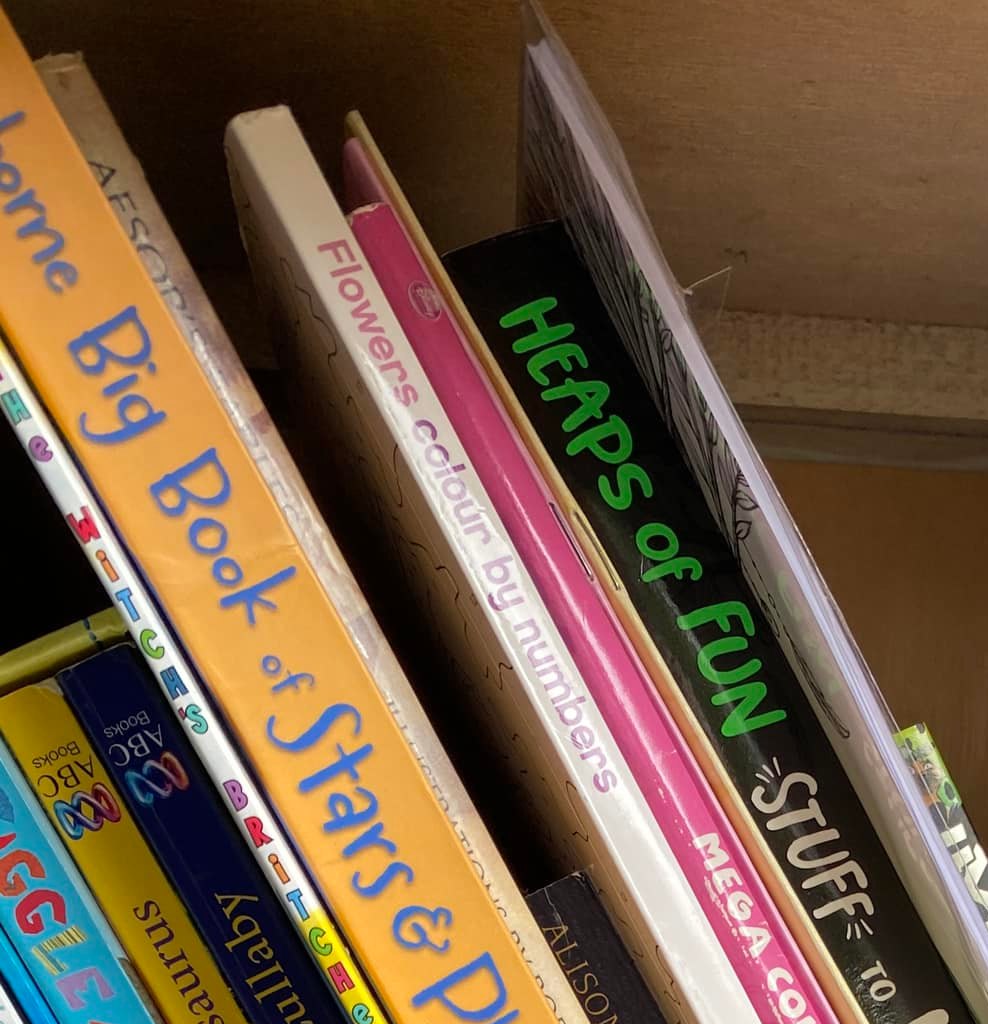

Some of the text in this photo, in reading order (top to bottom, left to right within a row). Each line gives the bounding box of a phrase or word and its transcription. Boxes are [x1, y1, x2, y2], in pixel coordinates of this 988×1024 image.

[68, 306, 167, 444] Big
[149, 447, 296, 625] Book
[317, 239, 618, 794] Flowers colour by numbers
[500, 296, 653, 510] HEAPS
[677, 601, 787, 737] FUN
[103, 709, 151, 739] Books
[261, 655, 314, 693] of
[32, 740, 81, 769] Books
[37, 755, 96, 799] ABC
[108, 723, 164, 768] ABC
[266, 703, 414, 898] Stars
[693, 832, 772, 958] MEGA
[751, 771, 875, 920] STUFF
[392, 905, 453, 952] &
